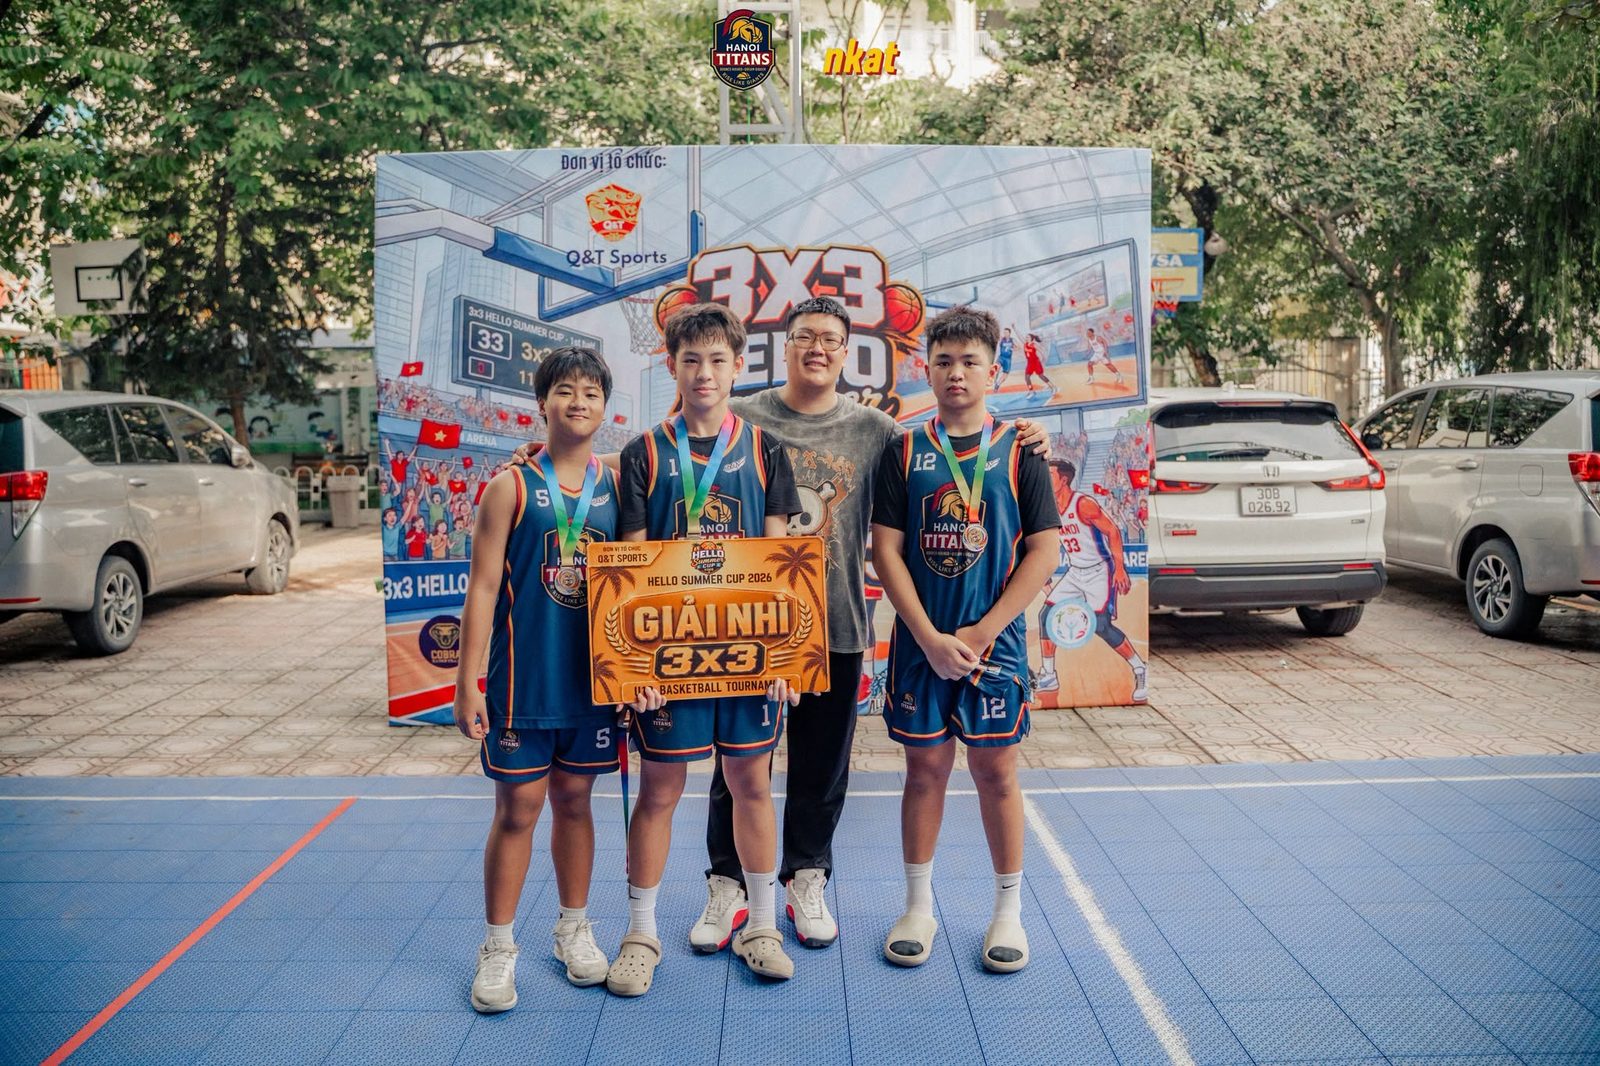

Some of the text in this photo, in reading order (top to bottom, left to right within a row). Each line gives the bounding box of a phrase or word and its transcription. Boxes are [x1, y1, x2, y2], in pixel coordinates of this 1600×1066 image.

[561, 154, 587, 170] Đơn
[592, 153, 603, 172] vị
[566, 250, 667, 267] Q&T Sports
[468, 306, 484, 319] 3x3
[485, 310, 512, 328] HELLO
[513, 319, 548, 338] SUMMER
[548, 329, 565, 342] CUP
[477, 328, 504, 353] 33
[466, 434, 497, 447] ARENA
[913, 452, 937, 472] 12
[535, 489, 550, 507] 5
[1257, 488, 1280, 499] 30B
[1249, 501, 1291, 513] 026.92
[698, 523, 728, 533] ANOI
[933, 523, 965, 532] HANO
[1063, 538, 1081, 553] 33
[617, 554, 648, 563] SPORTS
[692, 550, 724, 559] HELLO
[384, 573, 469, 600] 3x3 HELLO
[647, 573, 772, 587] HELLO SUMMER CUP 2026
[633, 594, 789, 642] GIẢI NHÌ
[660, 681, 721, 696] BASKETBALL
[761, 704, 770, 726] 1
[981, 697, 1006, 720] 12
[653, 720, 671, 728] TITANS
[595, 728, 610, 749] 5
